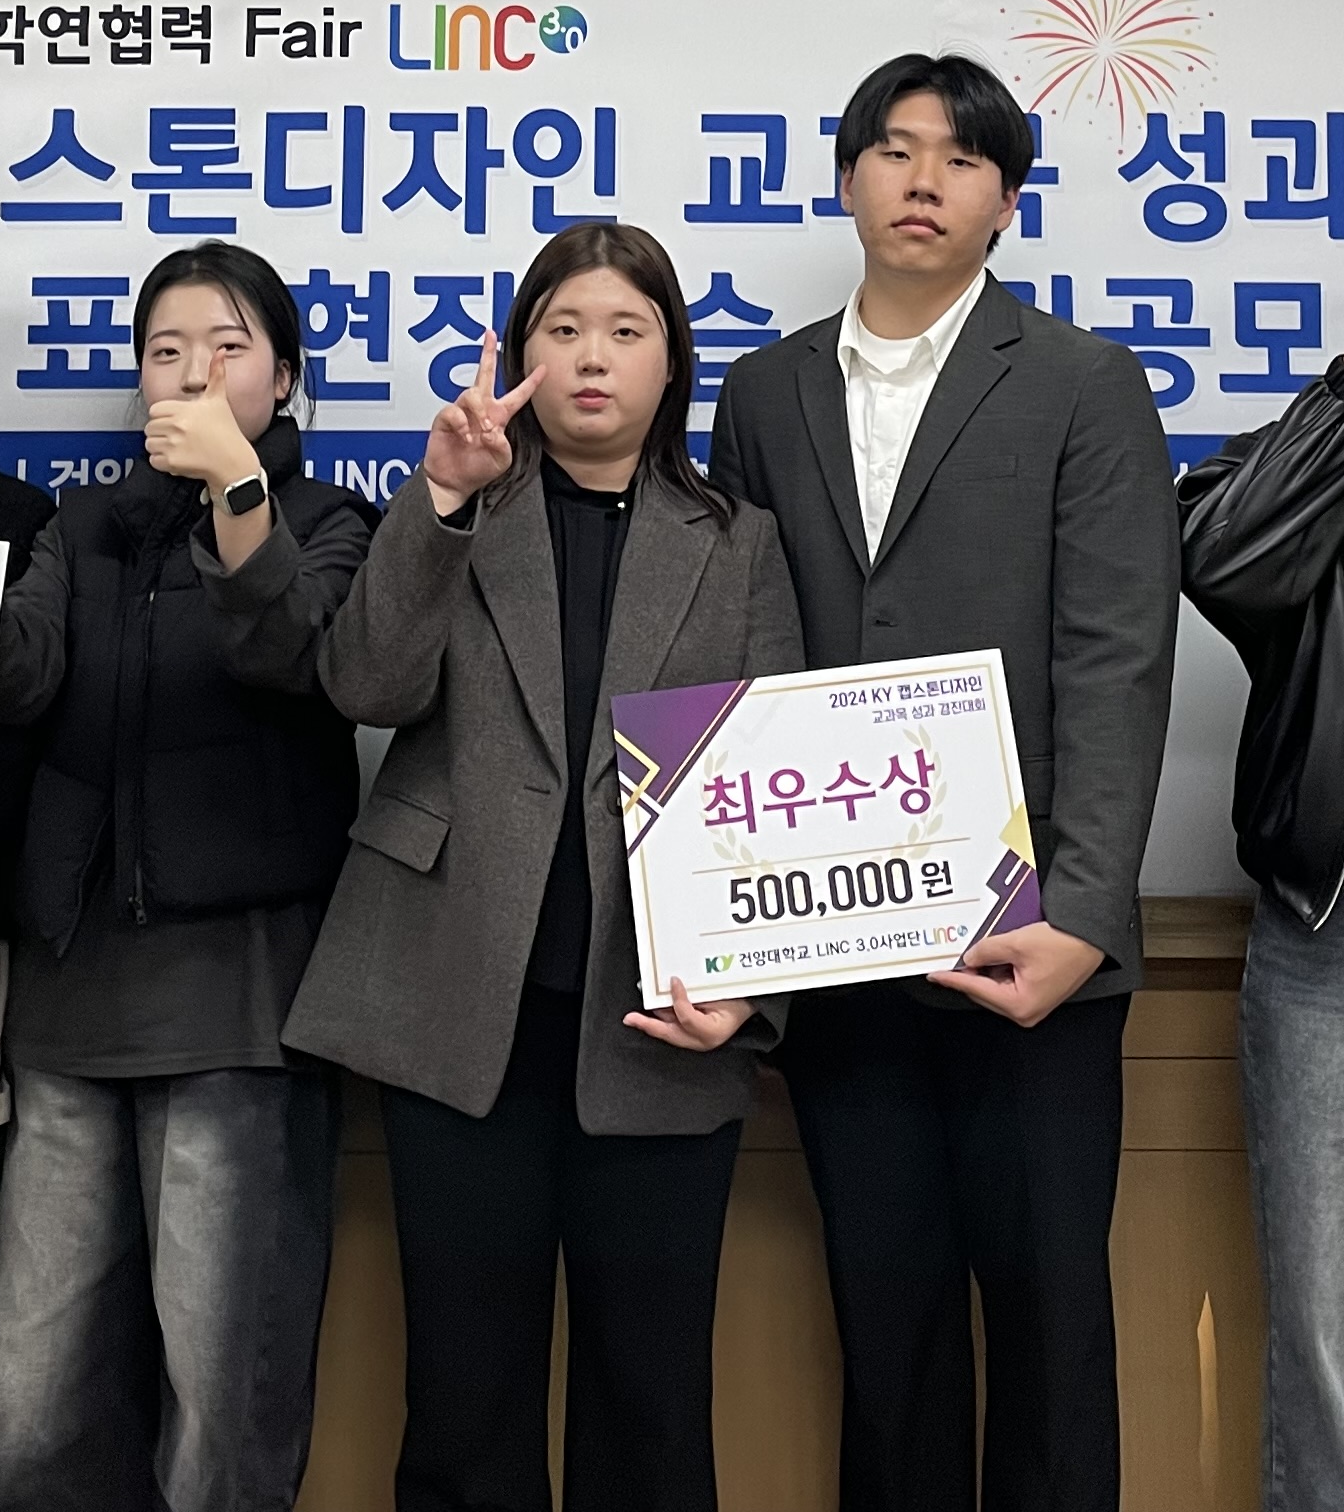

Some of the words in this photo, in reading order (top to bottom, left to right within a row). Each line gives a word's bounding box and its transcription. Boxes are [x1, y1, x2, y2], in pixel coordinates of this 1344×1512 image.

[245, 7, 362, 59] Fair
[829, 689, 867, 709] 2024
[871, 686, 892, 704] KY
[897, 675, 983, 700] 캡스톤디자인
[703, 749, 935, 834] 최우수상
[730, 858, 913, 925] 500,000
[921, 860, 954, 899] 원
[739, 945, 812, 968] 건양대학교
[816, 940, 850, 957] LINC
[856, 930, 921, 953] 3.0사업단
